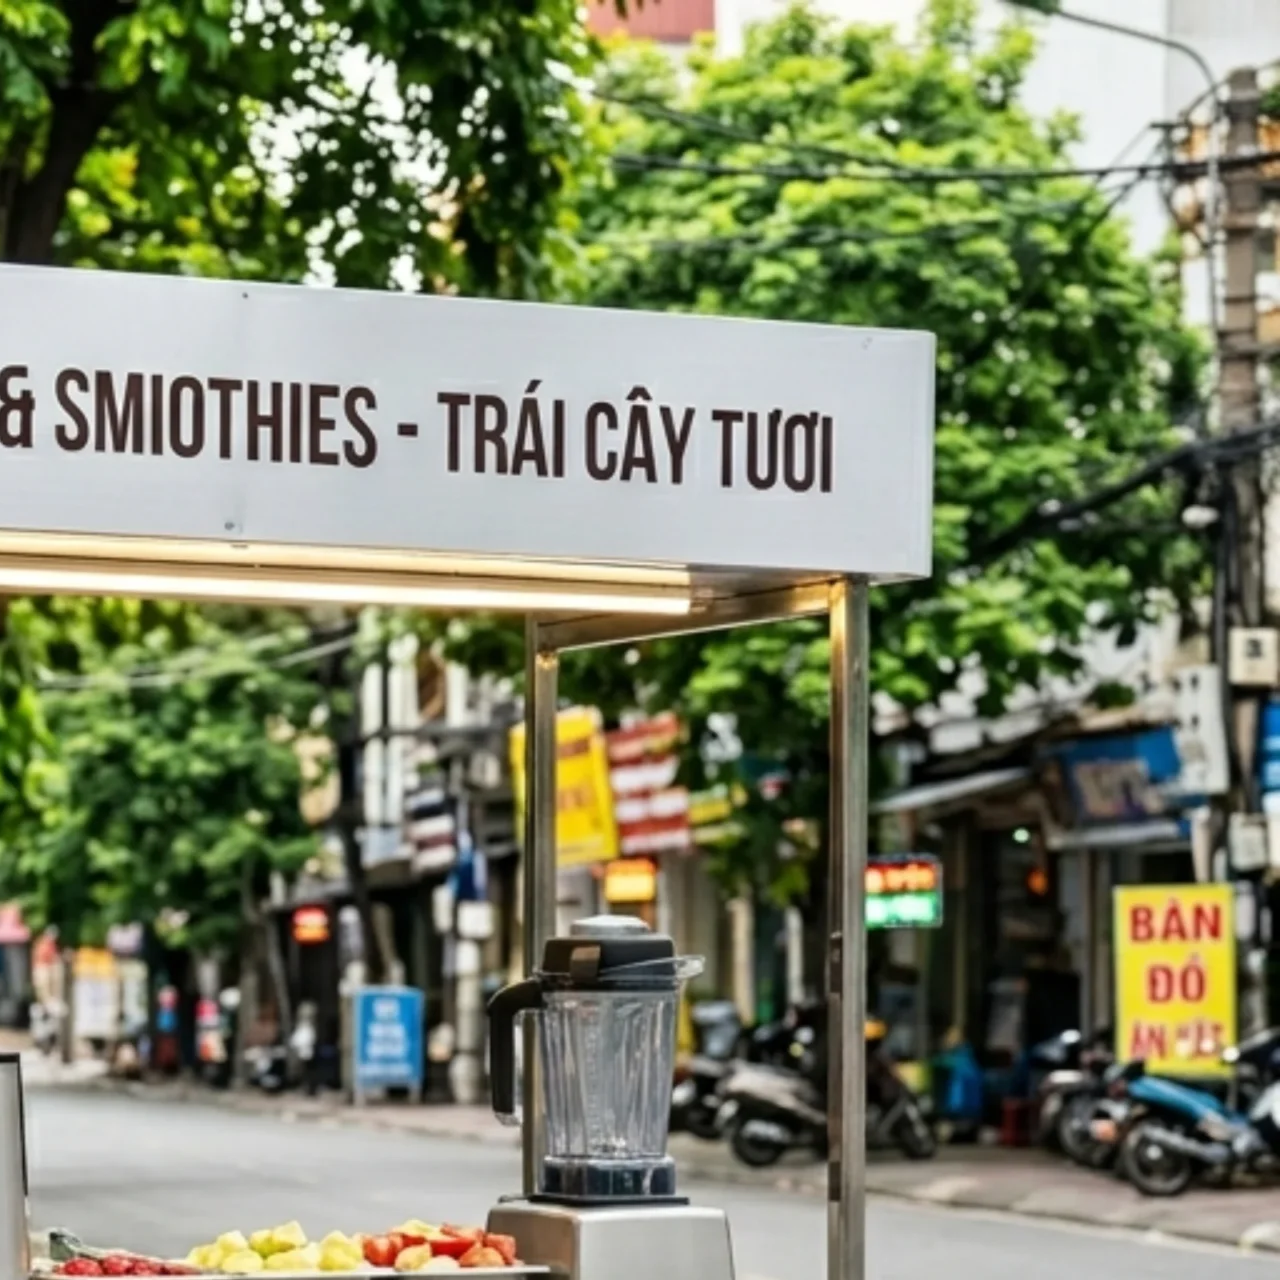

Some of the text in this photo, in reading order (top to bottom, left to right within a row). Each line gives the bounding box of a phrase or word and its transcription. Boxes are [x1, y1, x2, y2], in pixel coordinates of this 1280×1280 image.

[55, 367, 378, 469] SMIOTHIES
[437, 379, 566, 478] TRÁI
[585, 385, 696, 485] CÂY
[712, 408, 833, 493] TƯƠI
